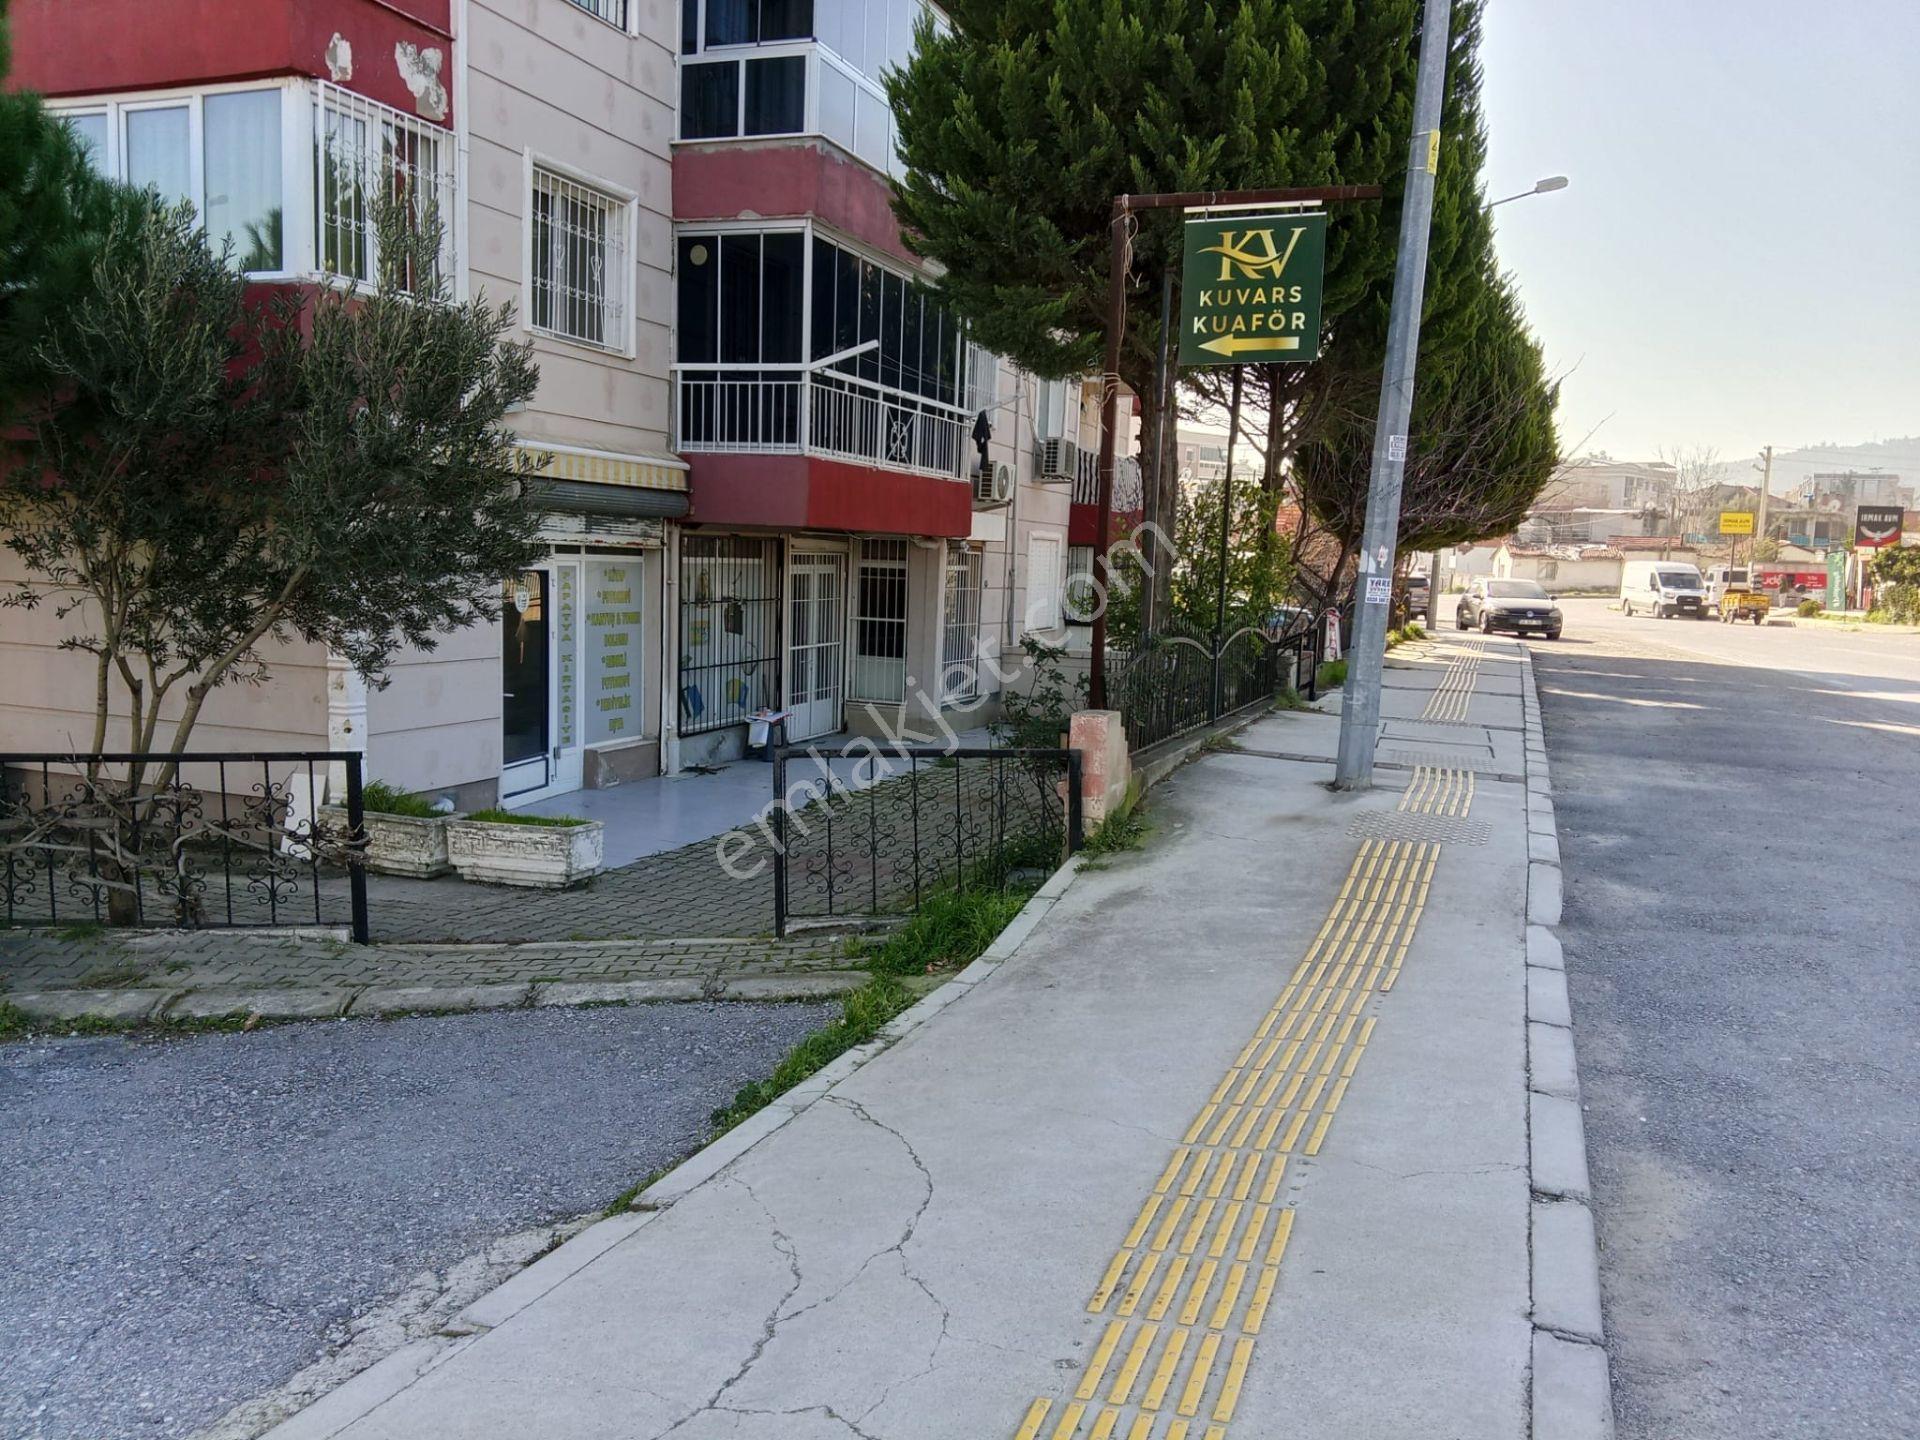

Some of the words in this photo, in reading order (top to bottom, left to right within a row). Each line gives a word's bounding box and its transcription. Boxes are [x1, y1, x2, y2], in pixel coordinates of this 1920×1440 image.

[1200, 286, 1302, 307] KUVARS
[1193, 309, 1306, 334] KUAFÖR
[561, 571, 572, 642] PAPATYA
